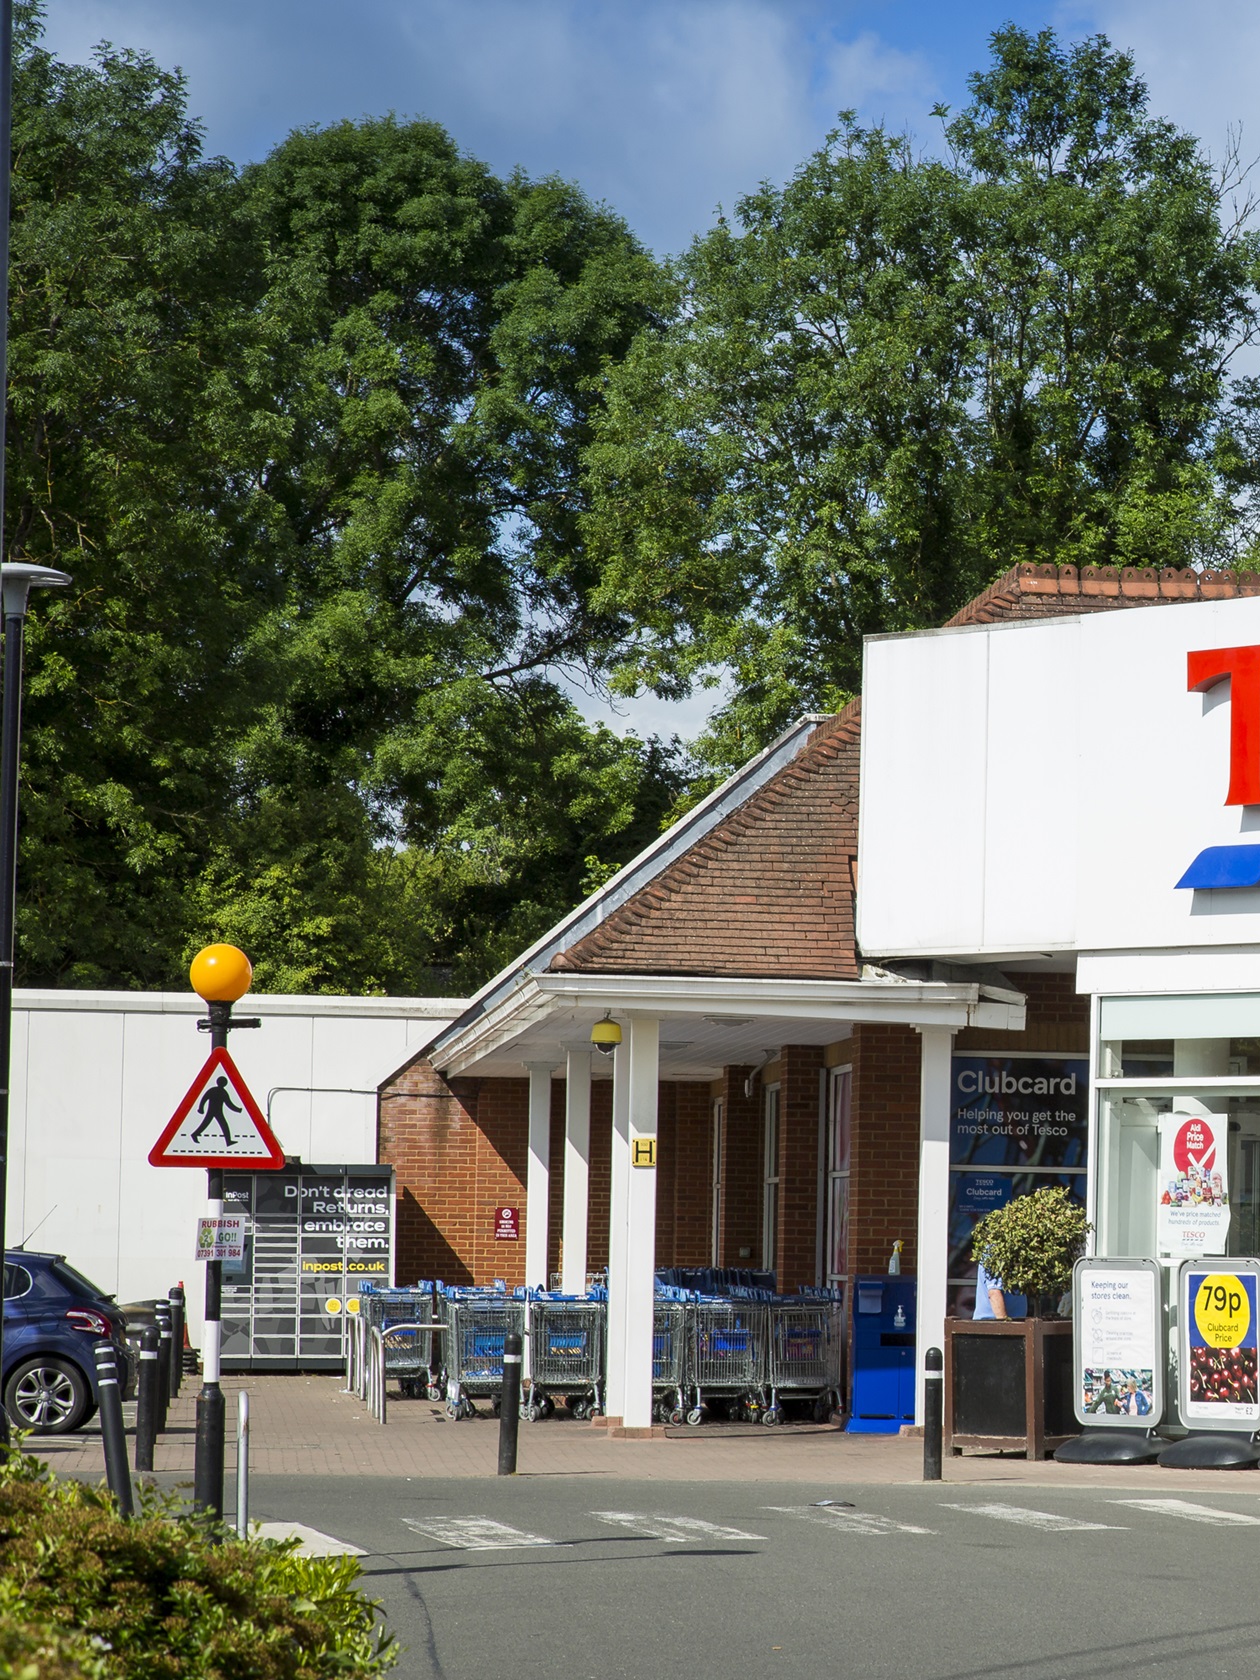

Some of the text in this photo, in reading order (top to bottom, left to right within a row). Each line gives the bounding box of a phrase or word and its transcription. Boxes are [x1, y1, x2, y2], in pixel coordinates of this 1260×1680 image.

[957, 1070, 1076, 1095] Clubcard
[957, 1108, 1076, 1123] Helping you get the
[957, 1124, 1068, 1136] most out of Tesco
[1190, 1124, 1201, 1132] Aldi
[1186, 1132, 1204, 1141] Price
[1186, 1141, 1204, 1149] Match
[636, 1141, 652, 1163] H
[225, 1191, 249, 1199] InPost
[285, 1186, 387, 1198] Don't dread
[966, 1188, 1002, 1196] Clubcard
[313, 1201, 389, 1215] Returns,
[1186, 1211, 1198, 1219] price
[202, 1220, 240, 1228] RUBBISH
[304, 1219, 385, 1232] embrace
[204, 1232, 237, 1243] 2 GO!!
[336, 1236, 389, 1248] them.
[197, 1249, 241, 1258] 07391 301 984
[302, 1261, 385, 1273] inpost.co.uk
[1091, 1281, 1116, 1290] Keeping
[1091, 1292, 1132, 1300] stores clean.
[1203, 1286, 1242, 1318] 79p
[1207, 1323, 1239, 1332] Clubcard
[1215, 1333, 1232, 1342] Price
